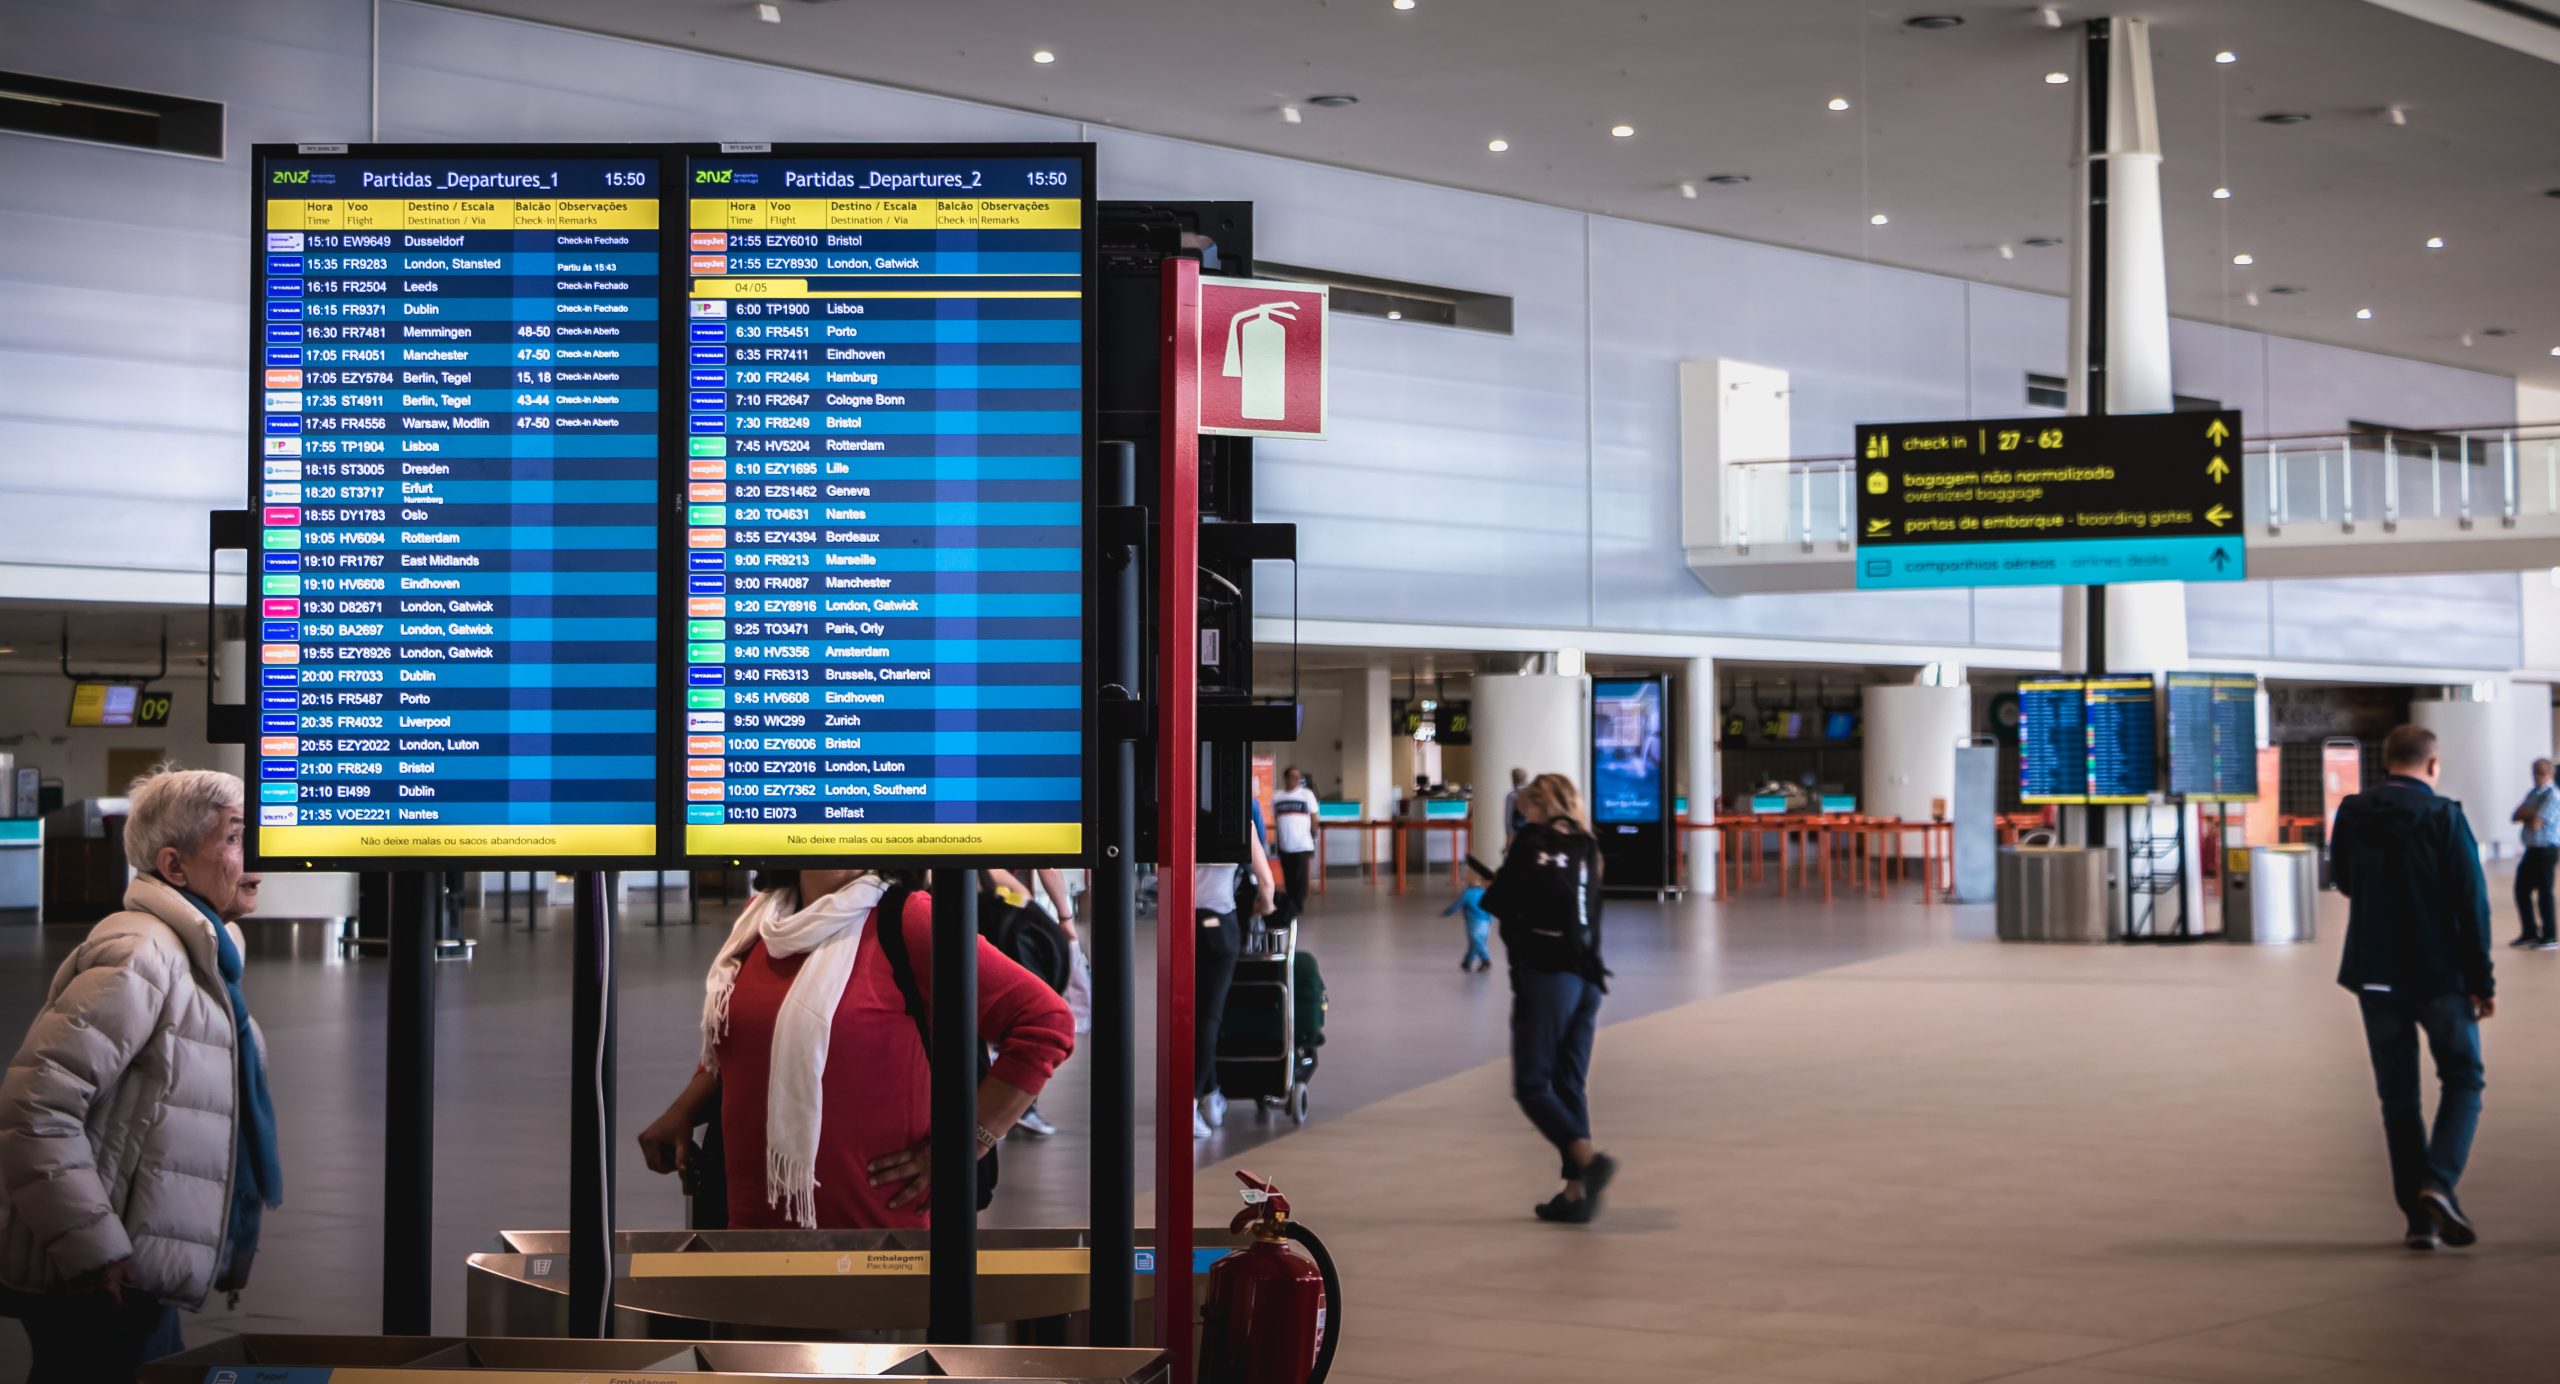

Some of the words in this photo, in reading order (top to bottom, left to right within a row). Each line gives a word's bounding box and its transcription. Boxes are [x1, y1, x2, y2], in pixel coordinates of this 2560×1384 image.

[363, 171, 432, 188] Partidas
[436, 171, 558, 191] _Departures_1
[605, 172, 646, 186] 15:50
[786, 171, 855, 188] Partidas
[859, 170, 982, 191] _Departures_2
[1027, 171, 1068, 186] 15:50
[307, 202, 333, 212] Hora
[347, 202, 369, 212] Voo
[408, 201, 450, 211] Destino
[461, 201, 495, 212] Escala
[515, 201, 551, 211] Balcão
[558, 201, 628, 213] Observações
[730, 201, 756, 211] Hora
[770, 201, 791, 211] Voo
[831, 201, 872, 211] Destino
[883, 201, 918, 211] Escala
[937, 201, 974, 211] Balcão
[980, 201, 1050, 213] Observações
[307, 216, 331, 225] Time
[347, 216, 373, 227] Flight
[408, 216, 461, 225] Destination
[471, 216, 486, 225] Via
[515, 216, 555, 225] Check-in
[558, 216, 598, 225] Remarks
[730, 216, 753, 225] Time
[770, 216, 796, 227] Flight
[831, 216, 883, 225] Destination
[893, 216, 909, 225] Via
[937, 216, 977, 225] Check-in
[981, 215, 1020, 225] Remarks
[307, 235, 339, 247] 15:10
[343, 235, 392, 247] EW9649
[404, 235, 465, 247] Dusseldorf
[557, 236, 592, 245] Check-in
[593, 236, 630, 245] Fechado
[730, 235, 762, 247] 21:55
[766, 235, 819, 247] EZY6010
[827, 234, 862, 247] Bristol
[307, 258, 338, 270] 15:35
[343, 258, 388, 270] FR9283
[404, 258, 449, 271] London,
[452, 258, 501, 270] Stansted
[557, 263, 582, 272] Partiu
[583, 263, 594, 272] às
[595, 263, 617, 272] 15:43
[734, 281, 768, 294] 04/05
[736, 303, 762, 315] 6:00
[765, 303, 810, 315] TP1900
[827, 303, 864, 315] Lisboa
[306, 327, 338, 339] 16:30
[342, 326, 386, 338] FR7481
[403, 325, 472, 340] Memmingen
[517, 325, 551, 338] 48-50
[556, 327, 591, 336] Check-in
[591, 327, 620, 336] Aberto
[306, 372, 337, 384] 17:05
[341, 372, 394, 384] EZY5784
[402, 371, 440, 386] Berlin,
[442, 371, 472, 386] Tegel
[516, 371, 535, 385] 15,
[537, 371, 552, 384] 18
[556, 372, 591, 381] Check-in
[591, 372, 620, 381] Aberto
[736, 394, 761, 406] 7:10
[765, 393, 810, 406] FR2647
[826, 393, 873, 408] Cologne
[875, 393, 906, 406] Bonn
[305, 417, 337, 430] 17:45
[341, 417, 386, 430] FR4556
[402, 417, 450, 430] Warsaw,
[452, 416, 490, 429] Modlin
[516, 416, 551, 429] 47-50
[556, 418, 591, 427] Check-in
[591, 418, 620, 427] Aberto
[1903, 435, 1950, 451] check
[1952, 435, 1968, 449] in
[1998, 430, 2021, 451] 27
[2038, 427, 2064, 449] 62
[1902, 471, 1980, 489] bagagem
[1981, 467, 2013, 485] não
[2014, 464, 2115, 484] normalizado
[304, 486, 336, 499] 18:20
[340, 486, 385, 499] ST3717
[401, 482, 434, 495] Erfurt
[735, 485, 761, 498] 8:20
[764, 485, 818, 498] EZS1462
[825, 484, 871, 497] Geneva
[1903, 486, 1974, 503] oversized
[1974, 485, 2044, 503] baggage
[1904, 516, 1957, 534] portas
[1958, 515, 1980, 530] de
[1982, 514, 2065, 531] embarque
[2076, 510, 2147, 528] boarding
[2148, 509, 2194, 528] gates
[303, 601, 335, 613] 19:30
[339, 600, 382, 613] D82671
[400, 600, 446, 614] London,
[448, 600, 494, 612] Gatwick
[734, 668, 760, 681] 9:40
[764, 668, 810, 681] FR6313
[825, 668, 877, 682] Brussels,
[879, 668, 931, 681] Charleroi
[141, 698, 170, 721] 09
[300, 807, 333, 821] 21:35
[336, 808, 391, 821] VOE2221
[398, 808, 440, 820] Nantes
[360, 835, 381, 846] Não
[383, 836, 410, 846] deixe
[412, 836, 442, 846] malas
[443, 837, 457, 846] ou
[459, 837, 488, 846] sacos
[490, 835, 557, 846] abandonados
[787, 833, 808, 844] Não
[809, 834, 836, 844] deixe
[839, 834, 868, 844] malas
[870, 836, 883, 844] ou
[885, 836, 914, 844] sacos
[916, 833, 983, 844] abandonados
[867, 1254, 924, 1263] Embalagem
[867, 1262, 913, 1271] Packaging
